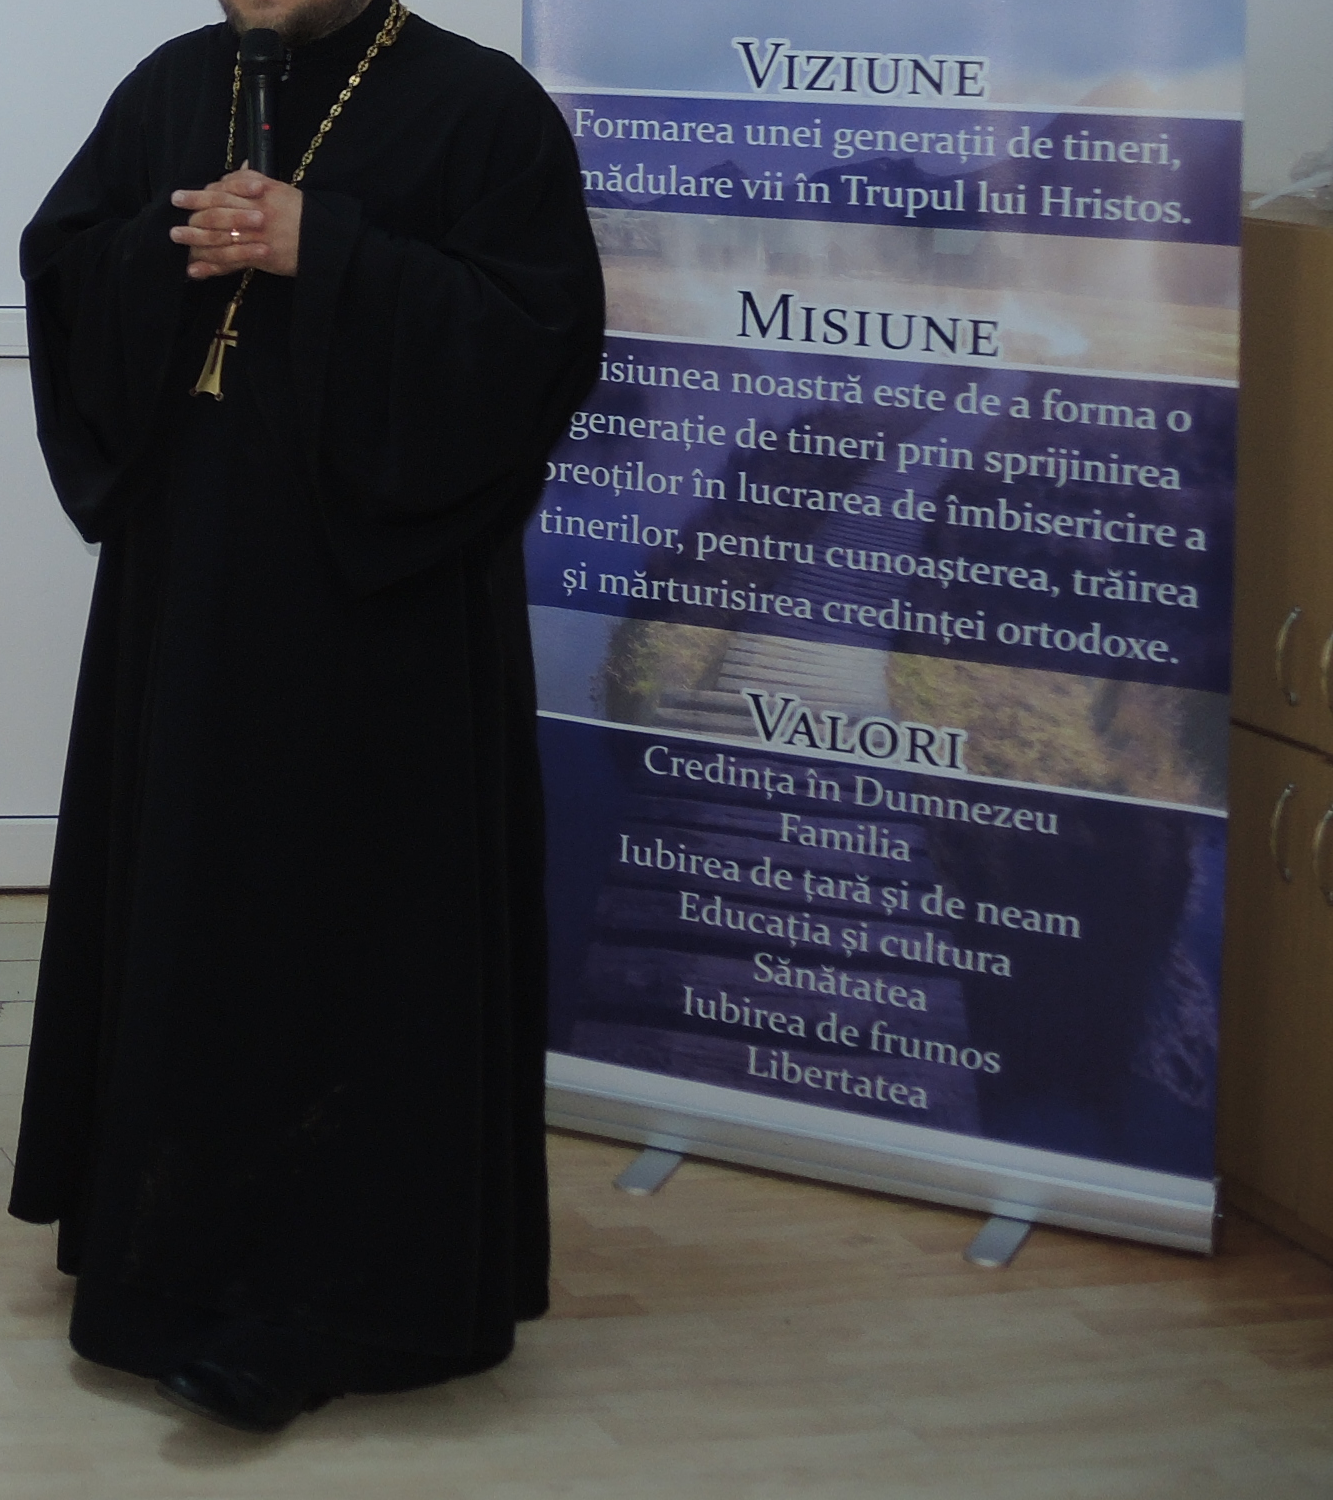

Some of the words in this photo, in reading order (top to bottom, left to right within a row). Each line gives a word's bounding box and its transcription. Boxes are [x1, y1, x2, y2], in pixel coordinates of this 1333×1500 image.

[735, 40, 986, 97] VIZIUNE
[574, 109, 734, 143] Formarea
[744, 119, 822, 147] unei
[834, 126, 996, 163] generații
[1006, 126, 1052, 158] de
[1063, 131, 1180, 169] tineri,
[742, 171, 784, 200] vii
[795, 173, 831, 203] în
[841, 175, 965, 217] Trupul
[978, 181, 1026, 214] lui
[1041, 186, 1190, 223] Hristos.
[737, 290, 999, 357] MISIUNE
[601, 353, 720, 391] isiunea
[732, 373, 863, 403] noastră
[874, 384, 945, 411] este
[956, 383, 1000, 415] de
[1010, 397, 1030, 418] a
[1042, 389, 1156, 429] forma
[1167, 410, 1191, 432] o
[570, 413, 725, 451] generație
[736, 418, 777, 450] de
[787, 425, 886, 461] tineri
[897, 438, 974, 473] prin
[985, 448, 1181, 489] sprijinirea
[692, 468, 726, 499] în
[738, 472, 882, 516] lucrarea
[892, 489, 936, 522] de
[947, 495, 1176, 547] îmbisericire
[1185, 529, 1206, 551] a
[540, 507, 683, 553] tinerilor,
[696, 532, 815, 564] pentru
[825, 547, 1059, 597] cunoașterea,
[1073, 570, 1198, 608] trăirea
[564, 562, 587, 596] și
[599, 571, 813, 619] mărturisirea
[823, 599, 985, 644] credinței
[997, 623, 1178, 663] ortodoxe.
[747, 692, 963, 769] VALORI
[645, 746, 795, 799] Credința
[807, 768, 841, 802] în
[855, 774, 1059, 835] Dumnezeu
[780, 813, 910, 861] Familia
[620, 834, 740, 882] Iubirea
[751, 857, 792, 890] de
[804, 870, 871, 904] țară
[882, 881, 908, 915] și
[921, 885, 965, 919] de
[977, 903, 1080, 938] neam
[680, 891, 831, 946] Educația
[842, 922, 867, 956] și
[880, 932, 1011, 977] cultura
[754, 950, 927, 1011] Sănătatea
[684, 986, 805, 1037] Iubirea
[817, 1012, 858, 1046] de
[871, 1021, 1000, 1073] frumos
[748, 1045, 928, 1110] Libertatea
